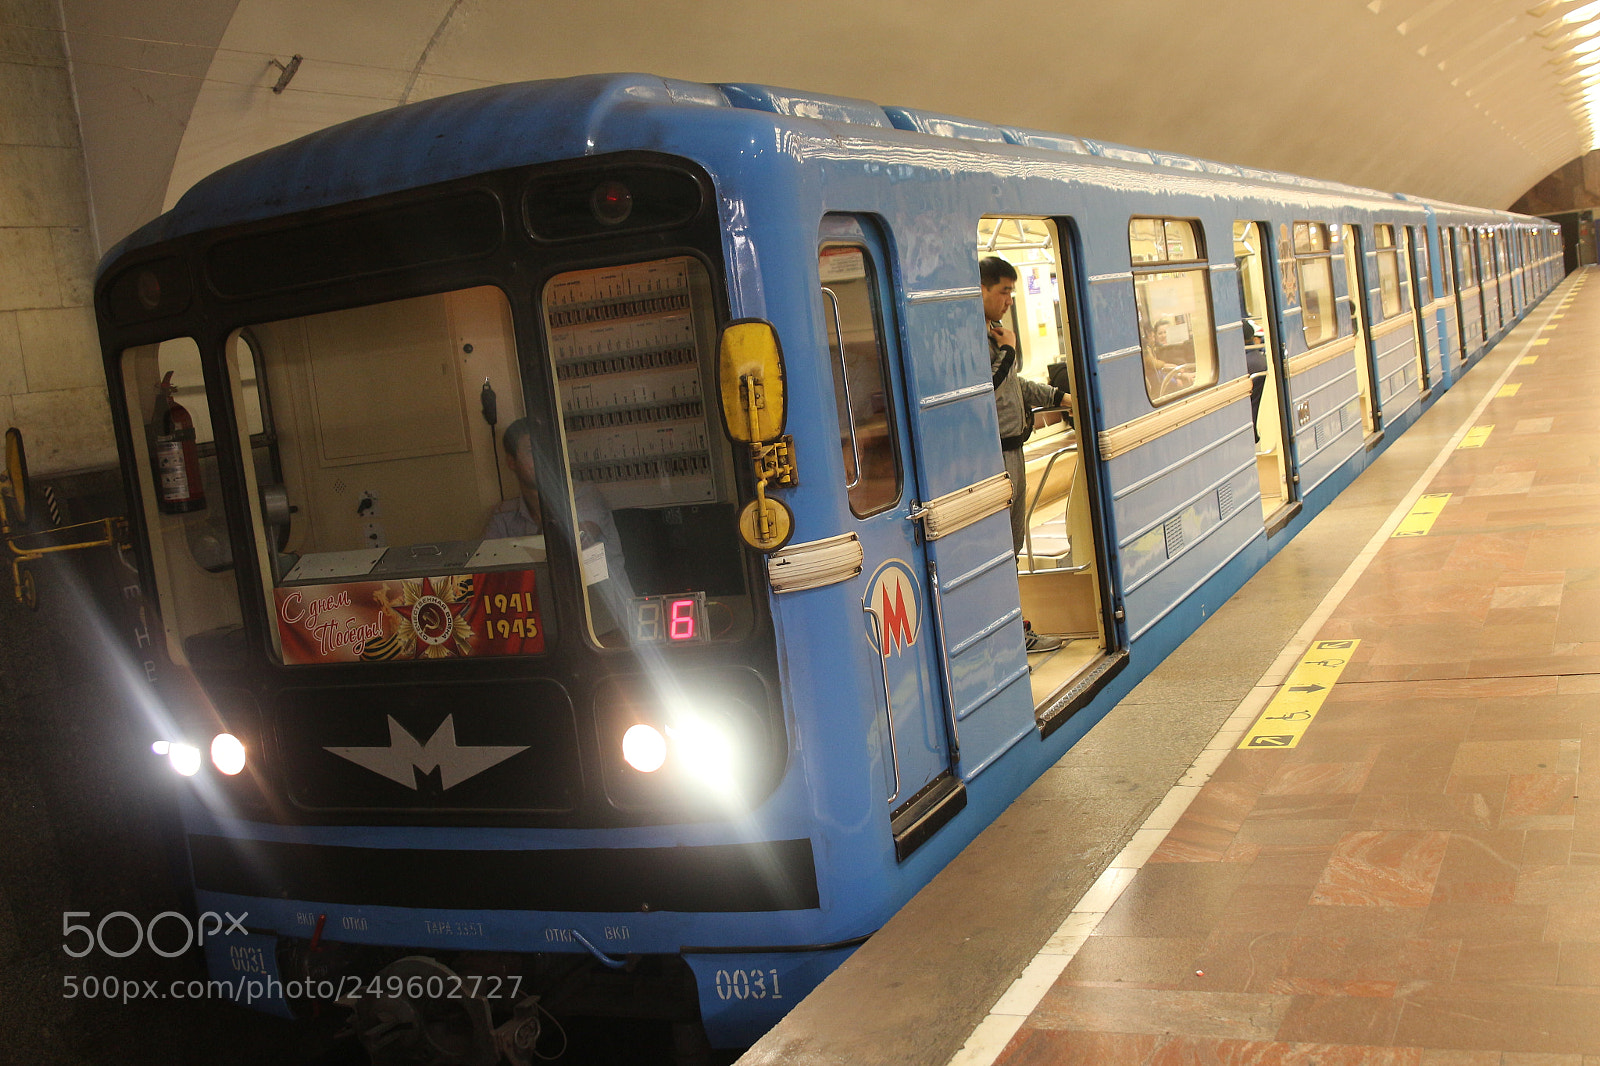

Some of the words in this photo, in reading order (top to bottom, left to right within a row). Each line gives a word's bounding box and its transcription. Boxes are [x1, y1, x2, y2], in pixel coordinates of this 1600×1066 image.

[281, 590, 305, 624] С
[484, 592, 534, 615] 1941
[313, 611, 384, 655] Победы!
[486, 617, 539, 640] 1945
[670, 600, 694, 640] 6
[230, 945, 267, 975] 0031
[715, 968, 782, 1000] 0031
